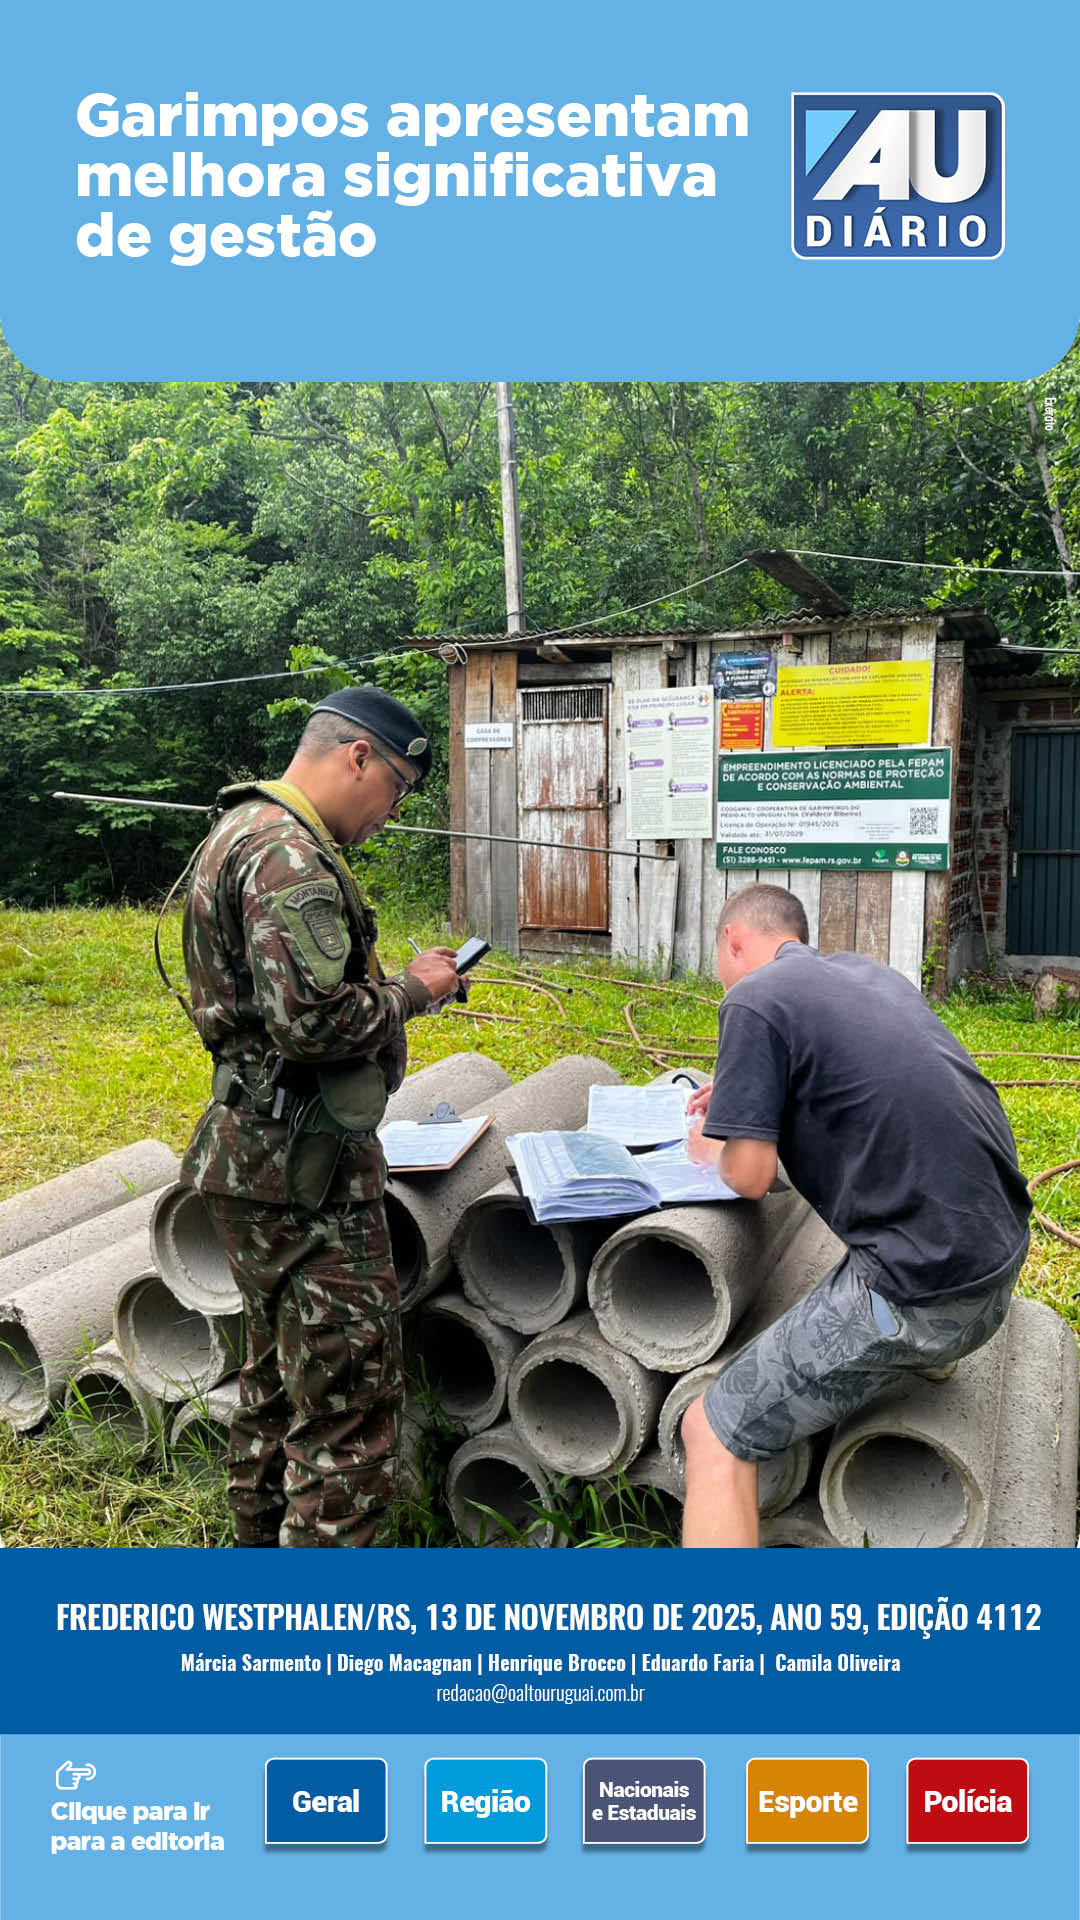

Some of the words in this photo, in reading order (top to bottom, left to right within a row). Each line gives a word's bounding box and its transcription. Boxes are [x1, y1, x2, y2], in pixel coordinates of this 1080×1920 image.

[829, 665, 871, 673] CUIDADO!
[780, 688, 814, 696] ALERTA:
[723, 761, 811, 772] EMPREENDIMENTO
[813, 759, 875, 770] LICENCIADO
[878, 759, 905, 768] PELA
[908, 757, 945, 767] FEPAM
[723, 773, 736, 782] DE
[738, 771, 779, 782] ACORDO
[781, 771, 804, 781] COM
[806, 771, 820, 780] AS
[822, 770, 866, 780] NORMAS
[869, 769, 883, 779] DE
[885, 767, 945, 779] PROTEÇÃO
[757, 782, 764, 791] E
[766, 779, 841, 791] CONSERVAÇÃO
[843, 780, 904, 790] AMBIENTAL
[755, 821, 787, 829] Operação
[723, 846, 744, 854] FALE
[744, 846, 786, 855] CONOSCO
[723, 856, 736, 865] (51)
[782, 856, 862, 866] www.fepam.rs.gov.br
[288, 887, 335, 906] MONTANHA
